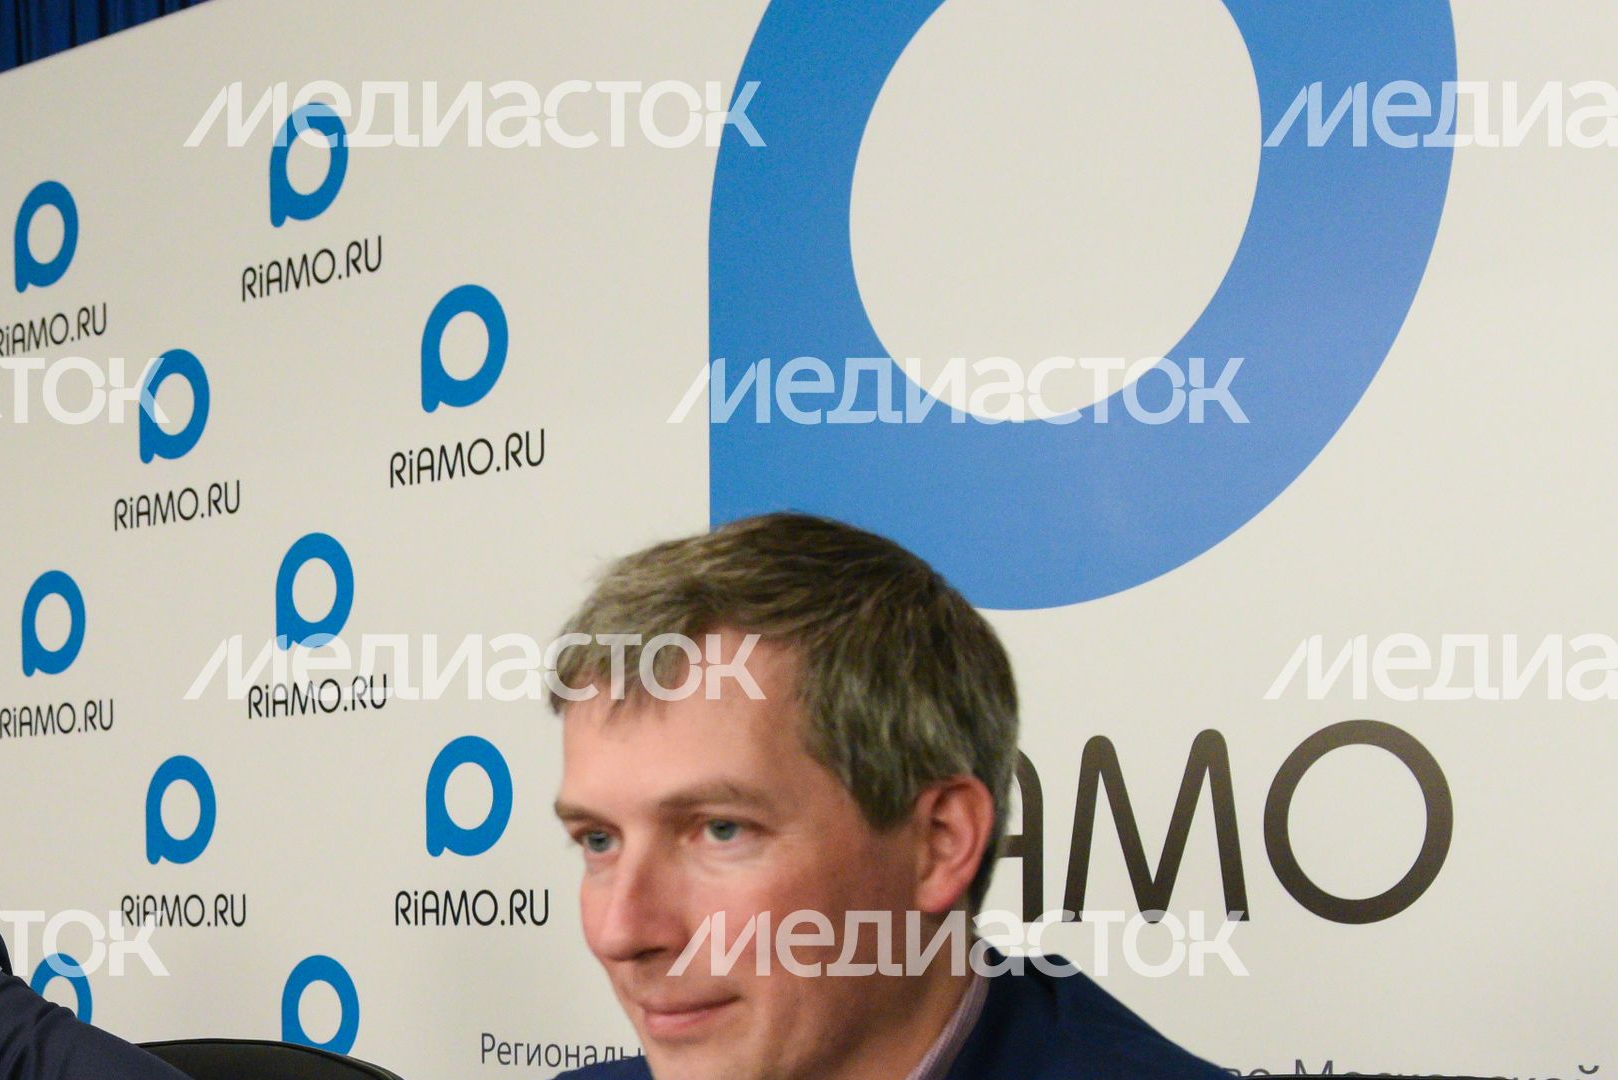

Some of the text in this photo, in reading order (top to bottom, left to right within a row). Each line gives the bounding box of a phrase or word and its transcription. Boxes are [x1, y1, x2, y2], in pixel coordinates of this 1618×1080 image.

[240, 234, 383, 303] RiAMO.RU
[388, 427, 547, 490] RiAMO.RU
[112, 478, 241, 532] RiAMO.RU
[247, 672, 388, 720] RiAMO.RU
[120, 892, 248, 928] RiAMO.RU
[394, 888, 550, 928] RiAMO.RU
